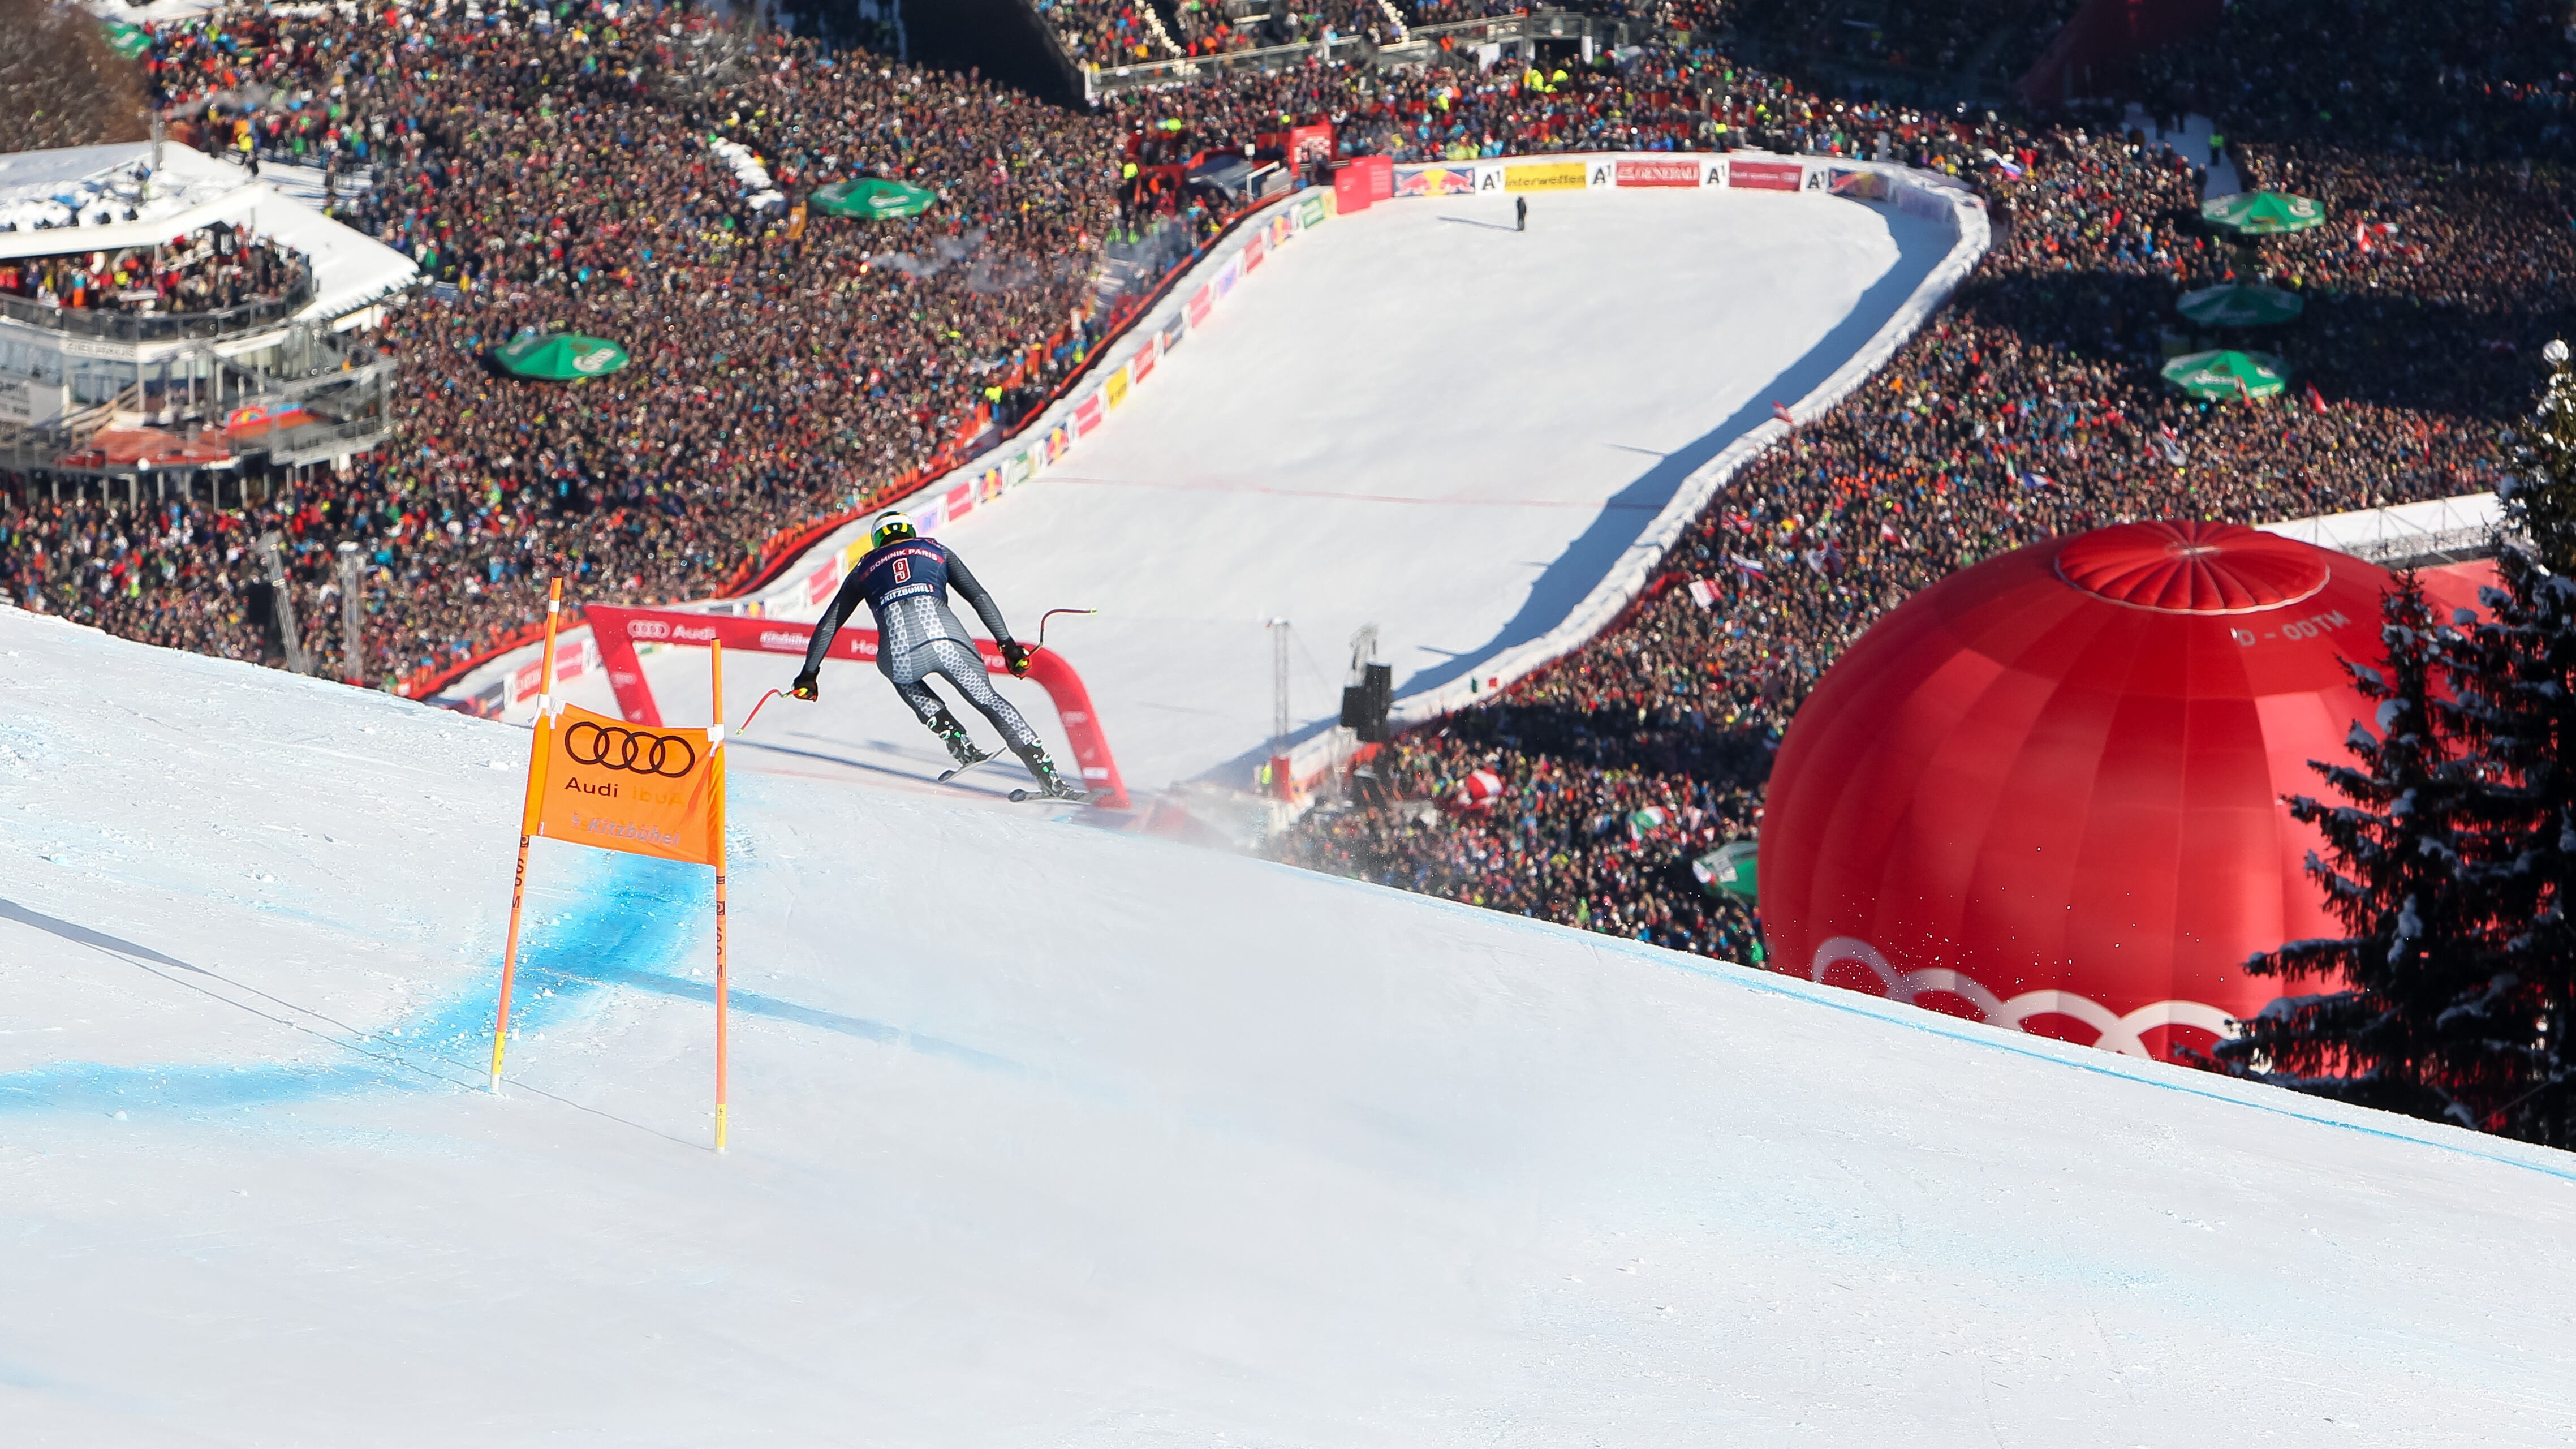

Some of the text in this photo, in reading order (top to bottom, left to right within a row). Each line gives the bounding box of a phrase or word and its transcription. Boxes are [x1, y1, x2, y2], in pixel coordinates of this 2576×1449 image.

[870, 548, 938, 572] DOMINIK PARIS
[892, 557, 911, 584] 9
[672, 625, 716, 640] Audi
[2236, 629, 2256, 646] D
[565, 777, 618, 797] Audi
[588, 818, 680, 846] Kitzbühel
